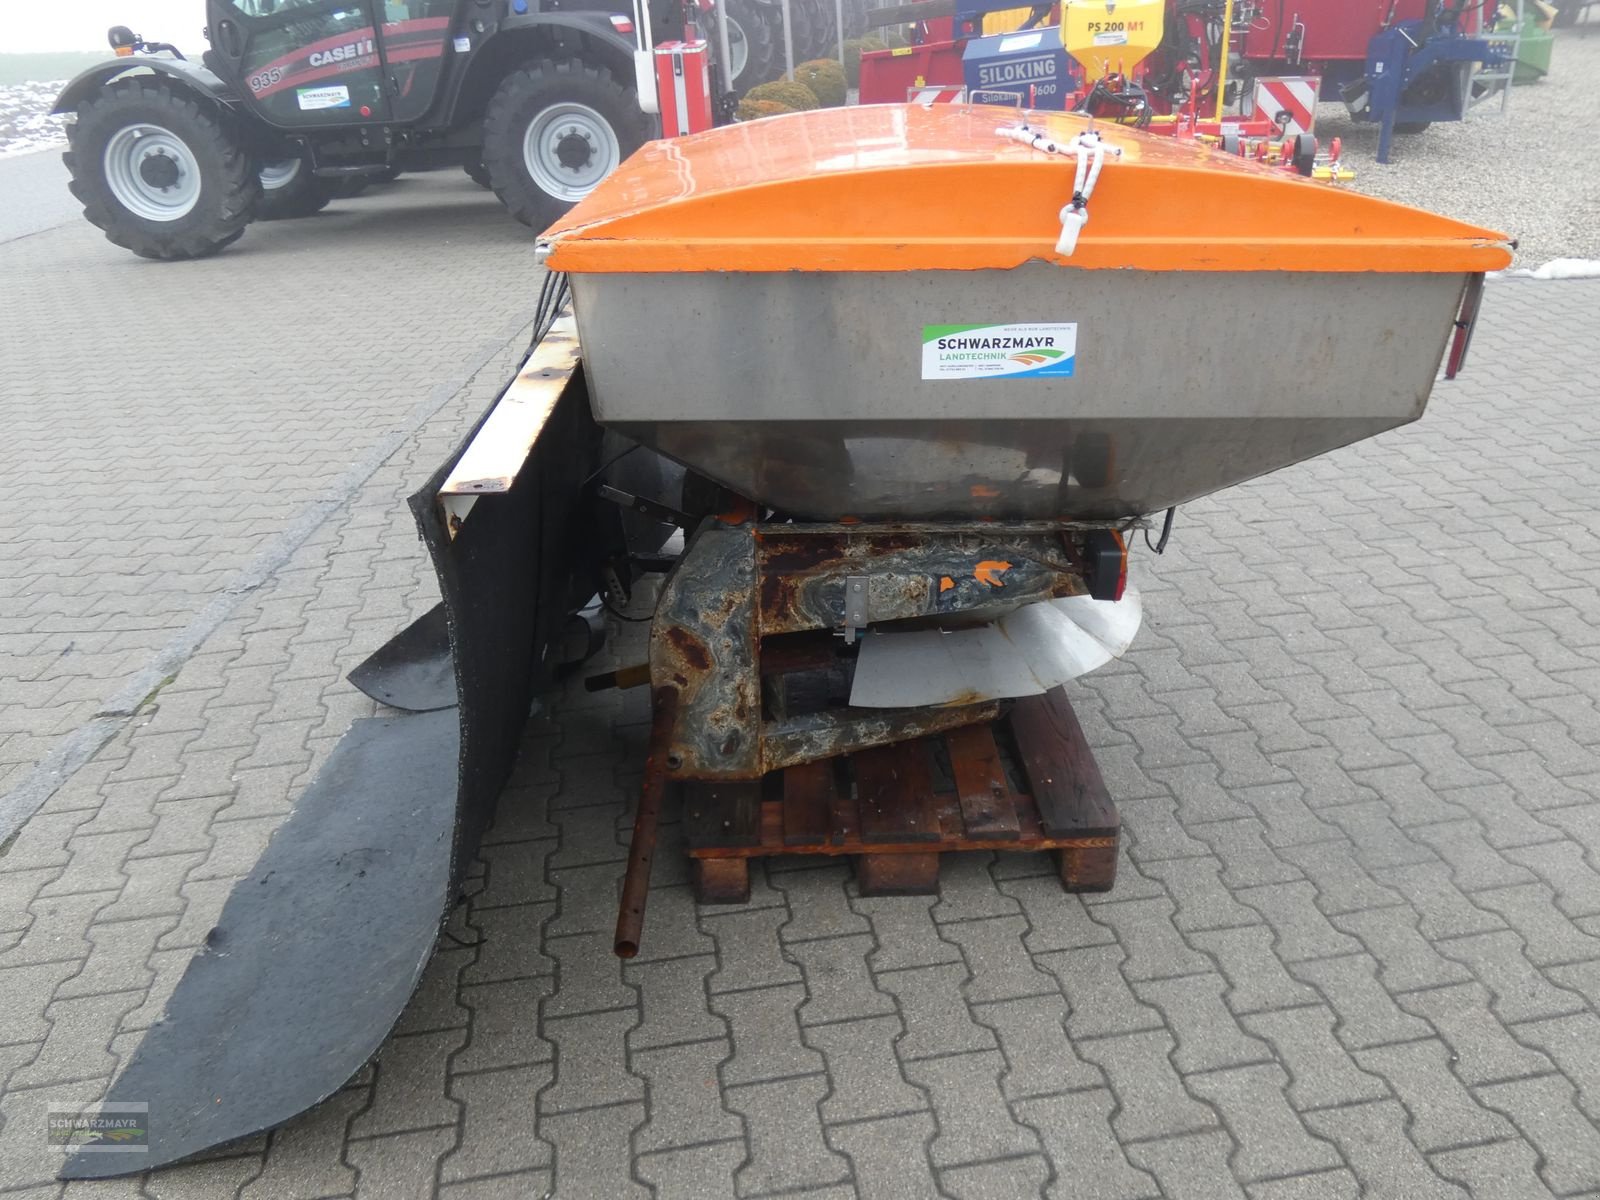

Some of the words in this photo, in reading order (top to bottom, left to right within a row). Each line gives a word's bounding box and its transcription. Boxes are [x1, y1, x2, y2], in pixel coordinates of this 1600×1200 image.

[1088, 22, 1101, 32] PS
[1104, 22, 1125, 32] 200
[1127, 21, 1144, 31] M1
[309, 43, 356, 67] CASE
[250, 66, 282, 93] 935
[979, 59, 1056, 84] SILOKING
[938, 336, 1055, 350] SCHWARZMAYR
[939, 352, 1007, 361] LANDTECHNIK
